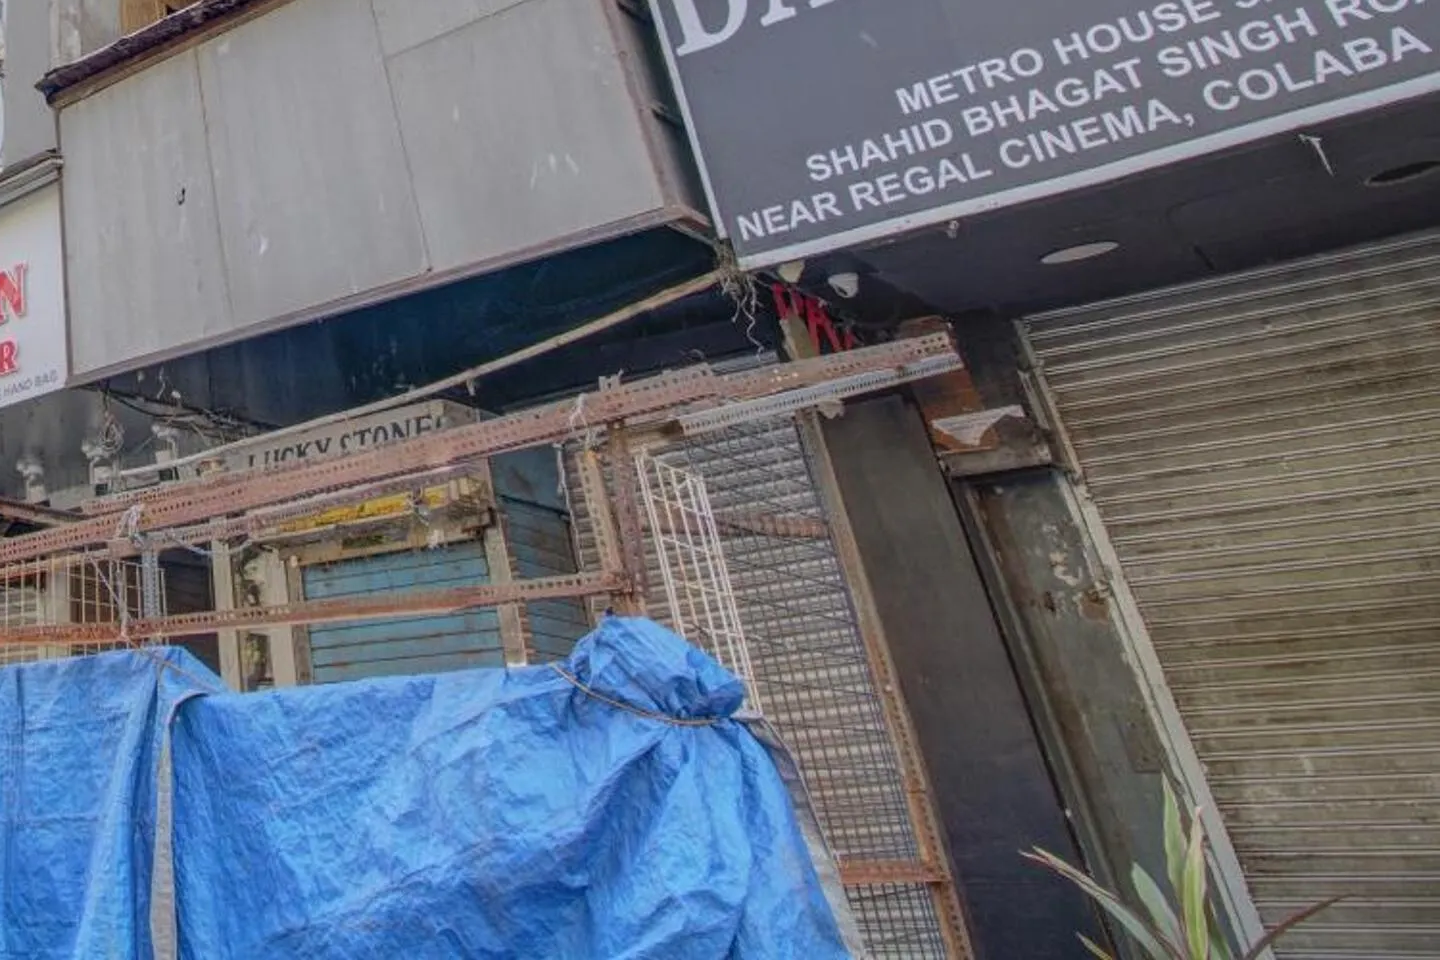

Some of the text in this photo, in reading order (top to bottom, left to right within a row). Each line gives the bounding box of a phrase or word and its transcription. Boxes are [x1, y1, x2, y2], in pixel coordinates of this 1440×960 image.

[806, 118, 953, 181] SHAHID
[962, 57, 1142, 136] BHAGAT
[1157, 7, 1318, 77] SINGH
[896, 48, 1044, 115] METRO
[737, 26, 1433, 241] NEAR REGAL CINEMA, COLABA
[3, 379, 33, 401] HAND
[248, 437, 333, 468] LUCKY
